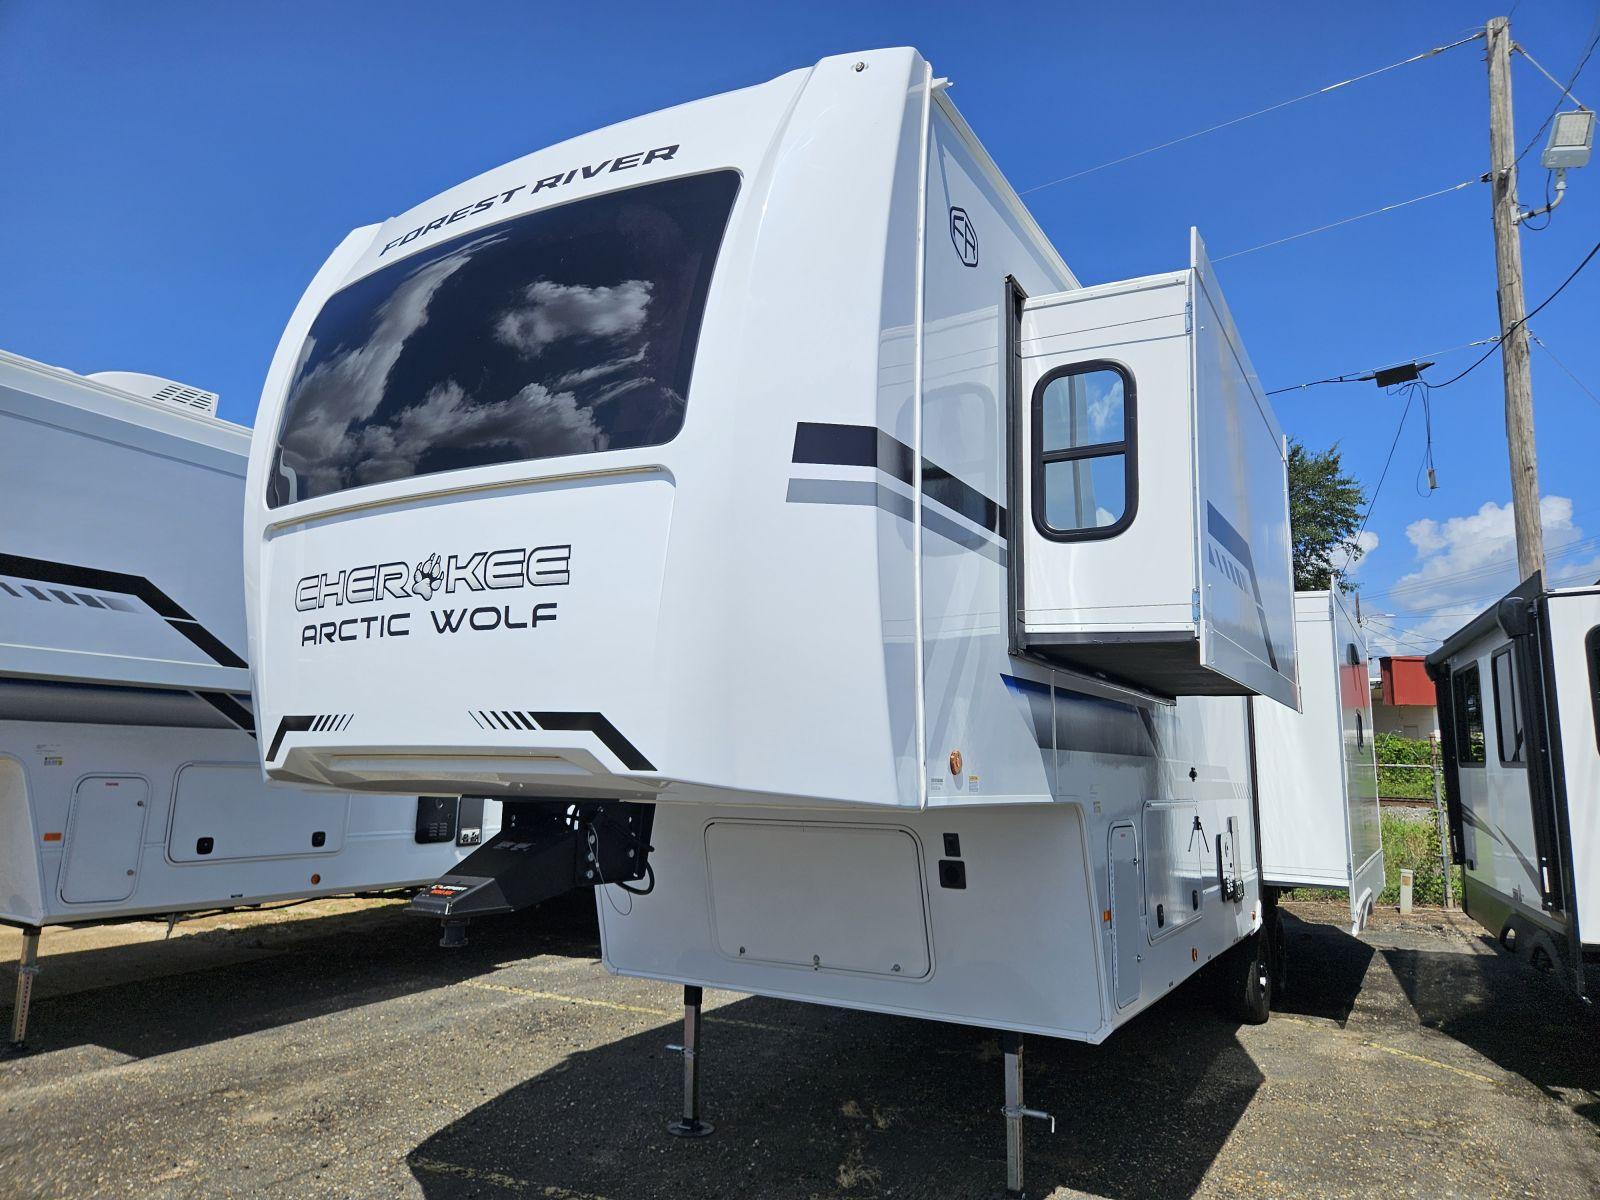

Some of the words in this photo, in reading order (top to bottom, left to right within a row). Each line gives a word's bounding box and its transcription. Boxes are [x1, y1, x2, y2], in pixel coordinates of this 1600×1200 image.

[378, 185, 526, 257] FOREST
[531, 144, 680, 195] RIVER
[301, 612, 411, 647] ARCTIC
[430, 602, 558, 635] WOLF
